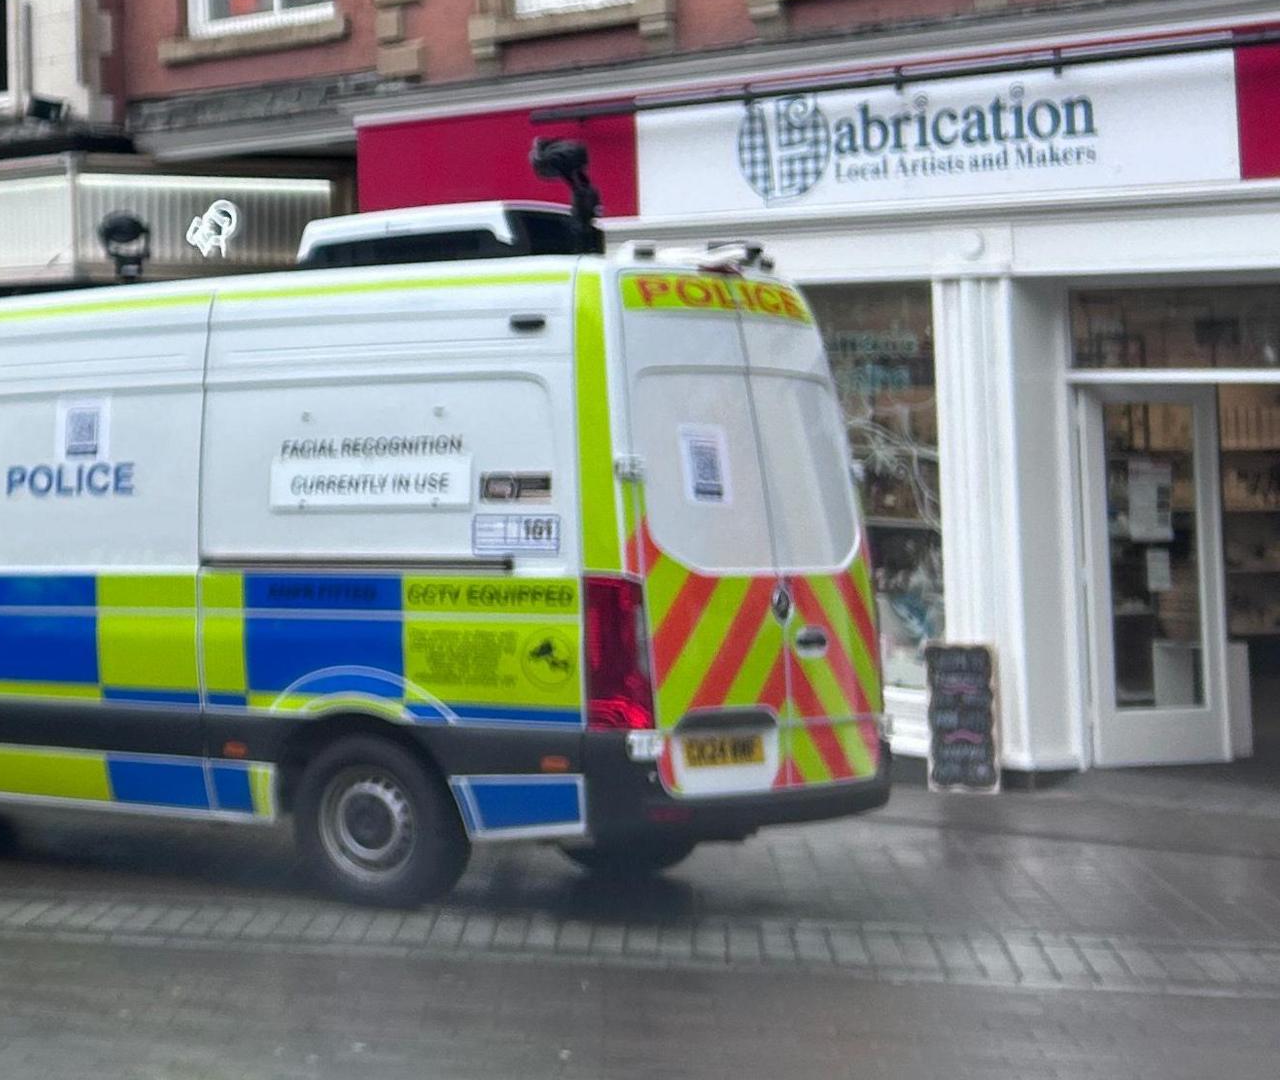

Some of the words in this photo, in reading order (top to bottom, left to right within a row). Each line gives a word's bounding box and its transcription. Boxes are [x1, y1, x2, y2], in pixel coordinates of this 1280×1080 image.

[835, 159, 889, 184] Local
[895, 152, 966, 178] Artists
[969, 149, 1010, 171] and
[1015, 142, 1097, 168] Makers
[634, 273, 808, 321] POLICE
[280, 437, 337, 459] FACIAL
[340, 433, 464, 458] RECOGNITION
[5, 461, 136, 498] POLICE
[290, 473, 388, 496] CURRENTLY
[392, 472, 410, 494] IN
[414, 471, 451, 494] USE
[465, 584, 574, 608] EQUIPPED
